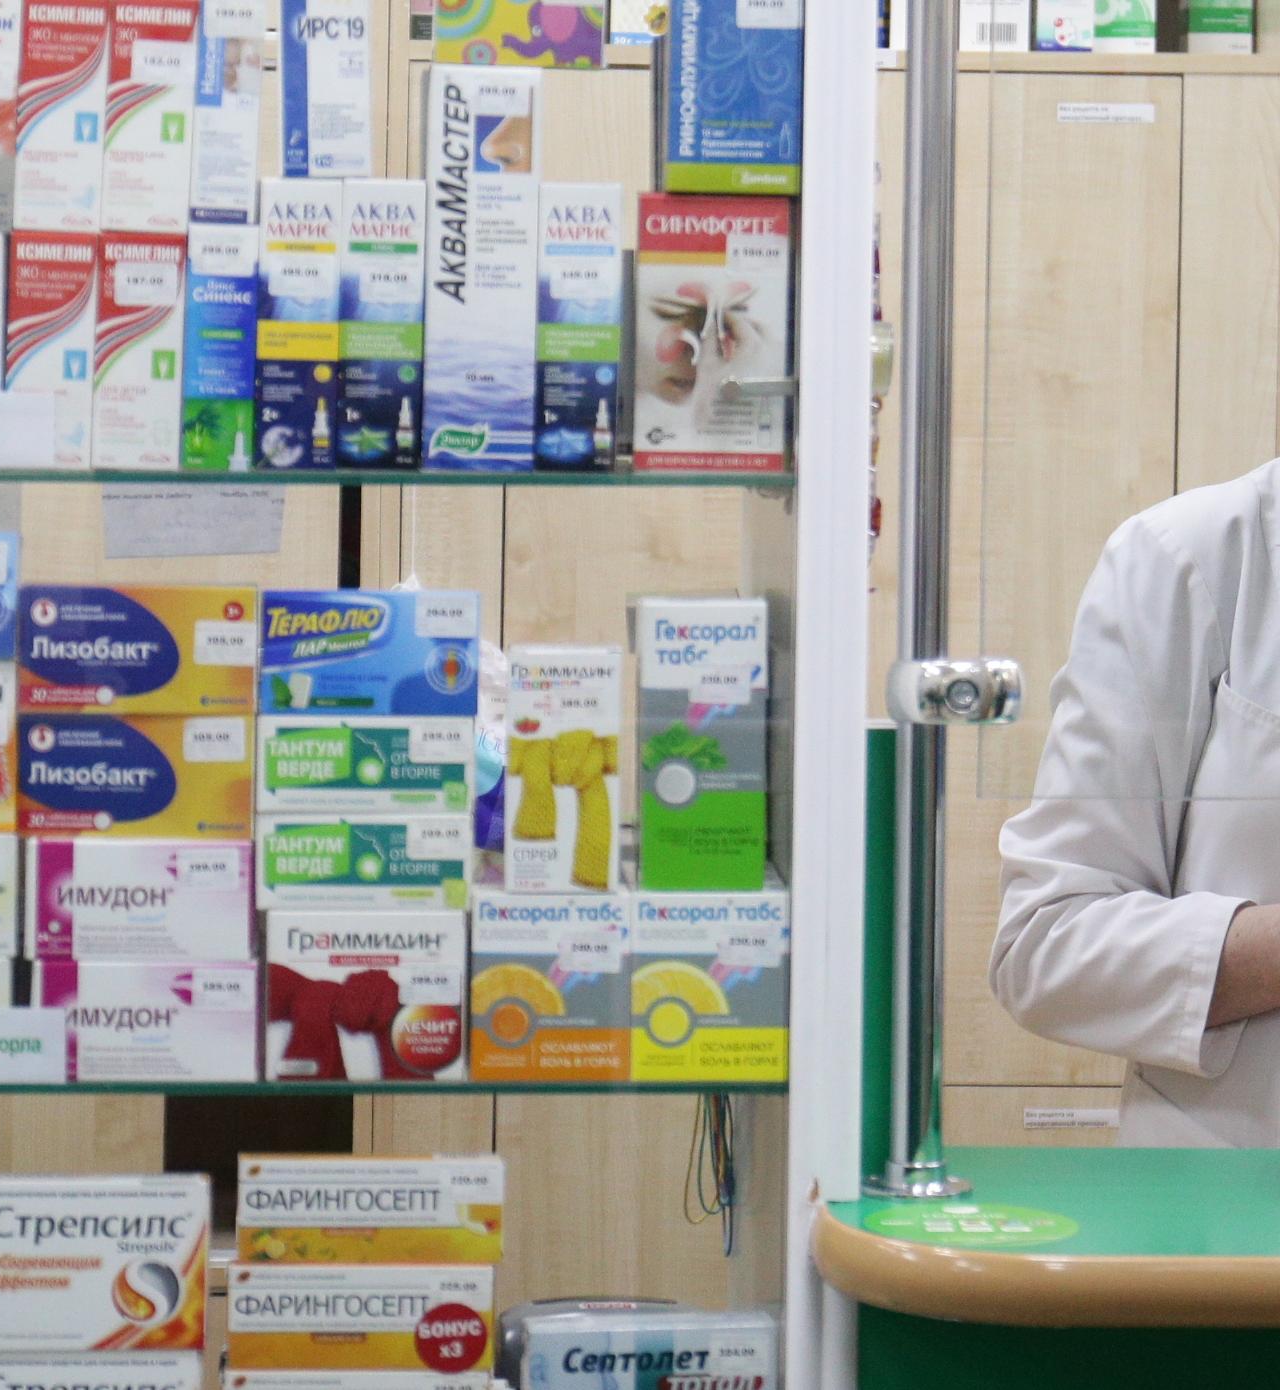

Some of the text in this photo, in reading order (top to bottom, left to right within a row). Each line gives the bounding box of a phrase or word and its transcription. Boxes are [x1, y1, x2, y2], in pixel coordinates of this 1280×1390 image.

[28, 5, 105, 25] КСИМЕЛИН
[116, 5, 192, 25] КСИМЕЛИН
[297, 17, 365, 38] ИРС 19
[269, 201, 334, 221] АКВА
[352, 201, 417, 221] АКВА
[546, 206, 612, 224] АКВА
[266, 221, 329, 239] МАРИС
[350, 221, 413, 239] МАРИС
[545, 225, 611, 242] МАРИС
[646, 213, 774, 235] СИНУФОРТЕ
[16, 244, 92, 263] КСИМЕЛИН
[192, 286, 253, 305] Синекс
[267, 607, 383, 638] ТЕРАФЛЮ
[655, 618, 758, 643] Гексорал
[30, 635, 151, 661] Лизобакт
[270, 739, 344, 758] ТАНТУМ
[27, 761, 149, 788] Лизобакт
[277, 760, 336, 780] ВЕРДЕ
[270, 837, 344, 854] ТАНТУМ
[276, 856, 335, 876] ВЕРДЕ
[57, 887, 168, 910] ИМУДОН
[478, 901, 624, 925] Гексорал табс
[638, 901, 782, 925] Гексорал табс
[287, 927, 442, 955] Граммидин
[66, 1007, 172, 1031] ИМУДОН
[245, 1188, 441, 1213] ФАРИНГОСЕПТ
[419, 1321, 482, 1340] БОНУС
[564, 1347, 709, 1374] Септолет
